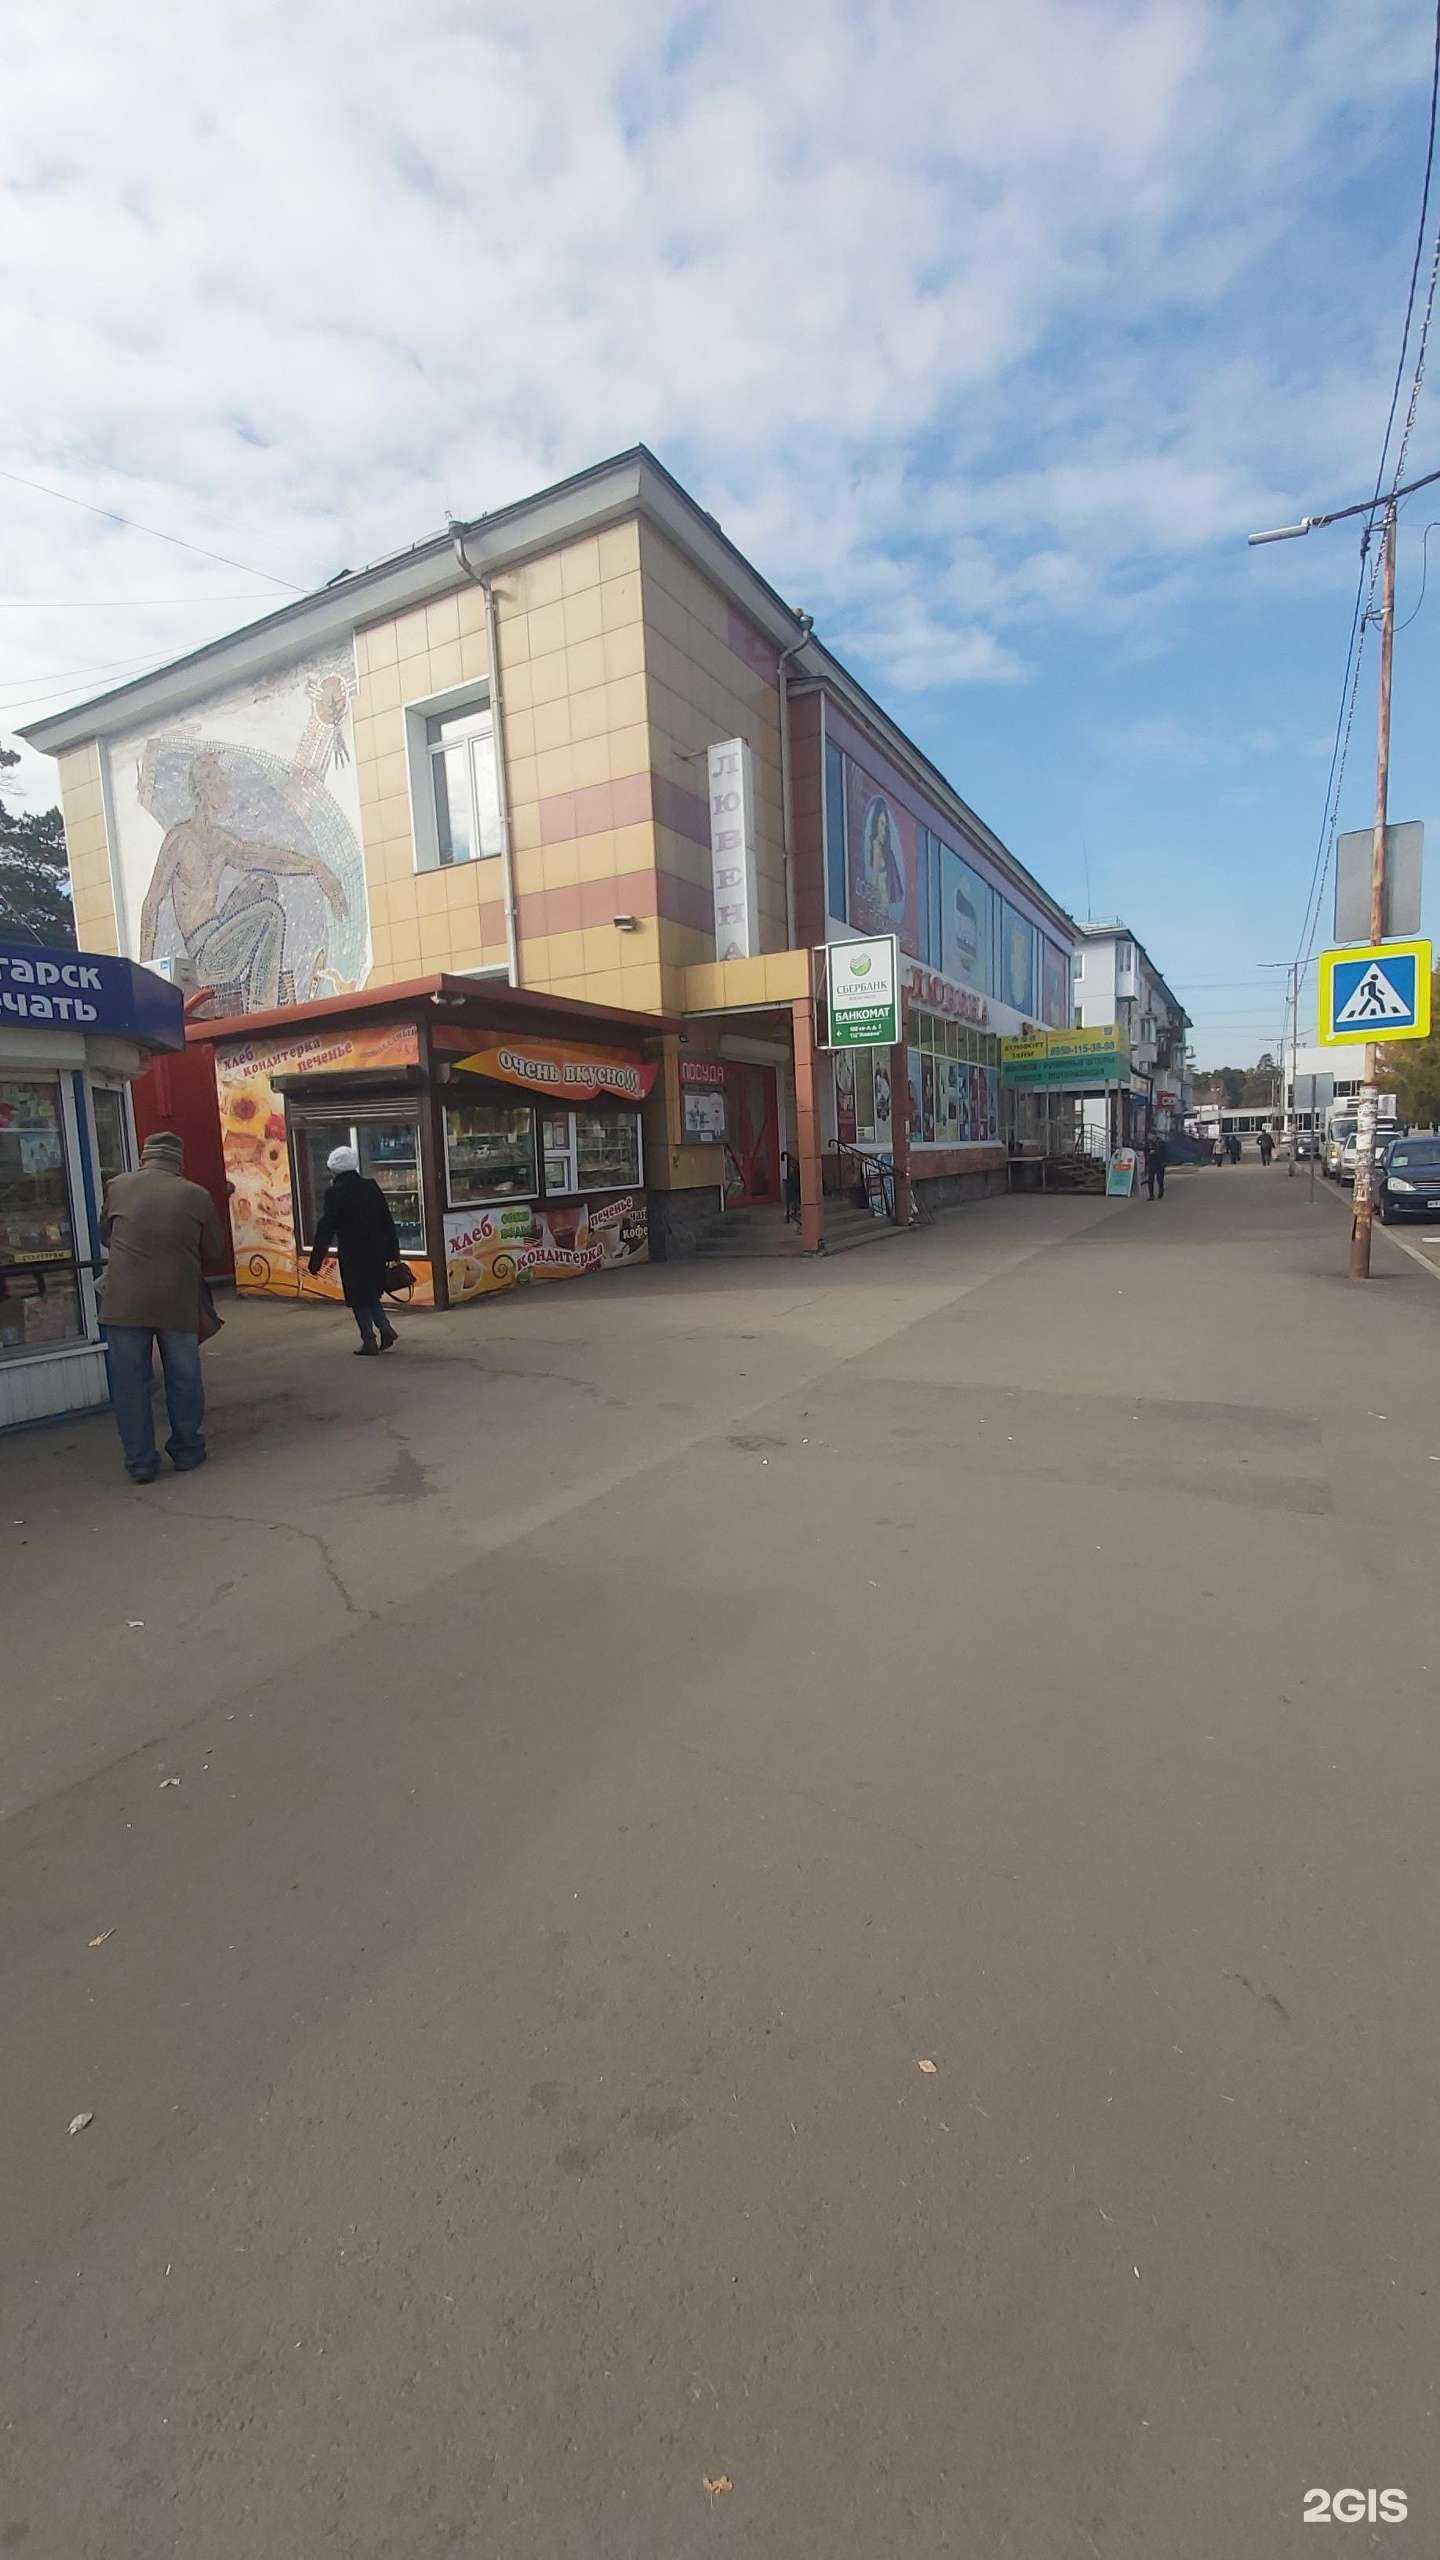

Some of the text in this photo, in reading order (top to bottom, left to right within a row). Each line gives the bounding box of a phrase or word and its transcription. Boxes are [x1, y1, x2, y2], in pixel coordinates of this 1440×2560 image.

[712, 752, 746, 961] ЛЮВЕНА
[836, 981, 889, 993] СБЕРБАНК
[0, 992, 98, 1021] чать
[835, 1007, 890, 1022] БАНКОМАТ
[223, 1044, 255, 1071] хлеб
[242, 1038, 321, 1077] кондитерка
[297, 1042, 353, 1073] печенье
[498, 1050, 561, 1083] очень
[683, 1062, 724, 1082] ПОСУДА
[590, 1196, 632, 1228] печенье
[448, 1213, 494, 1254] хлеб
[623, 1223, 648, 1241] кофе
[516, 1242, 605, 1272] кондитерка
